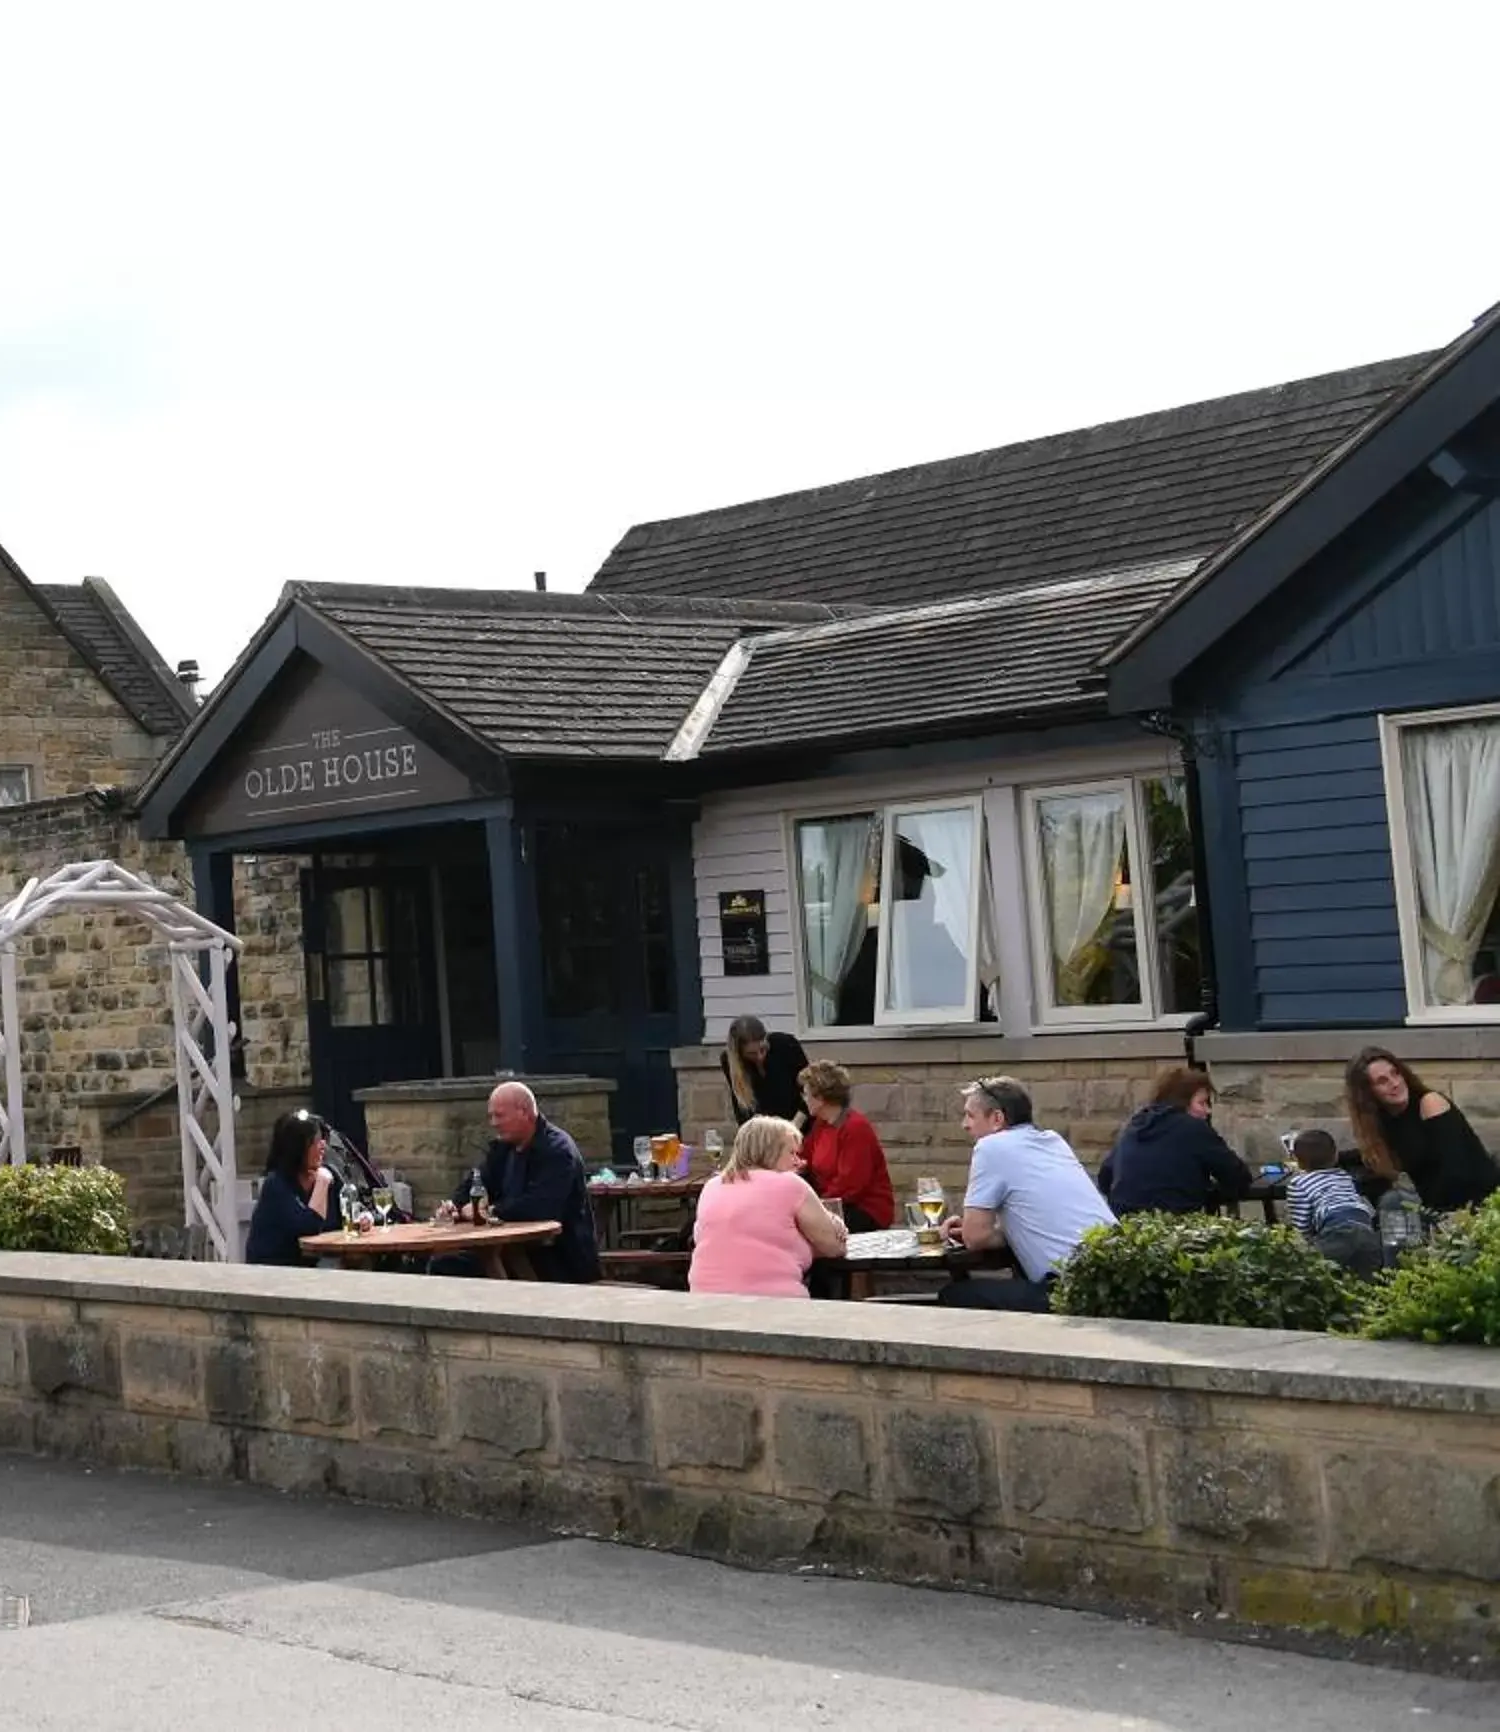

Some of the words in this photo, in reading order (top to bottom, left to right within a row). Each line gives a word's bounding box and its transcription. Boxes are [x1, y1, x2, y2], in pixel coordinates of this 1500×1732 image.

[312, 729, 341, 750] THE
[245, 761, 315, 799] OLDE
[322, 744, 418, 788] HOUSE
